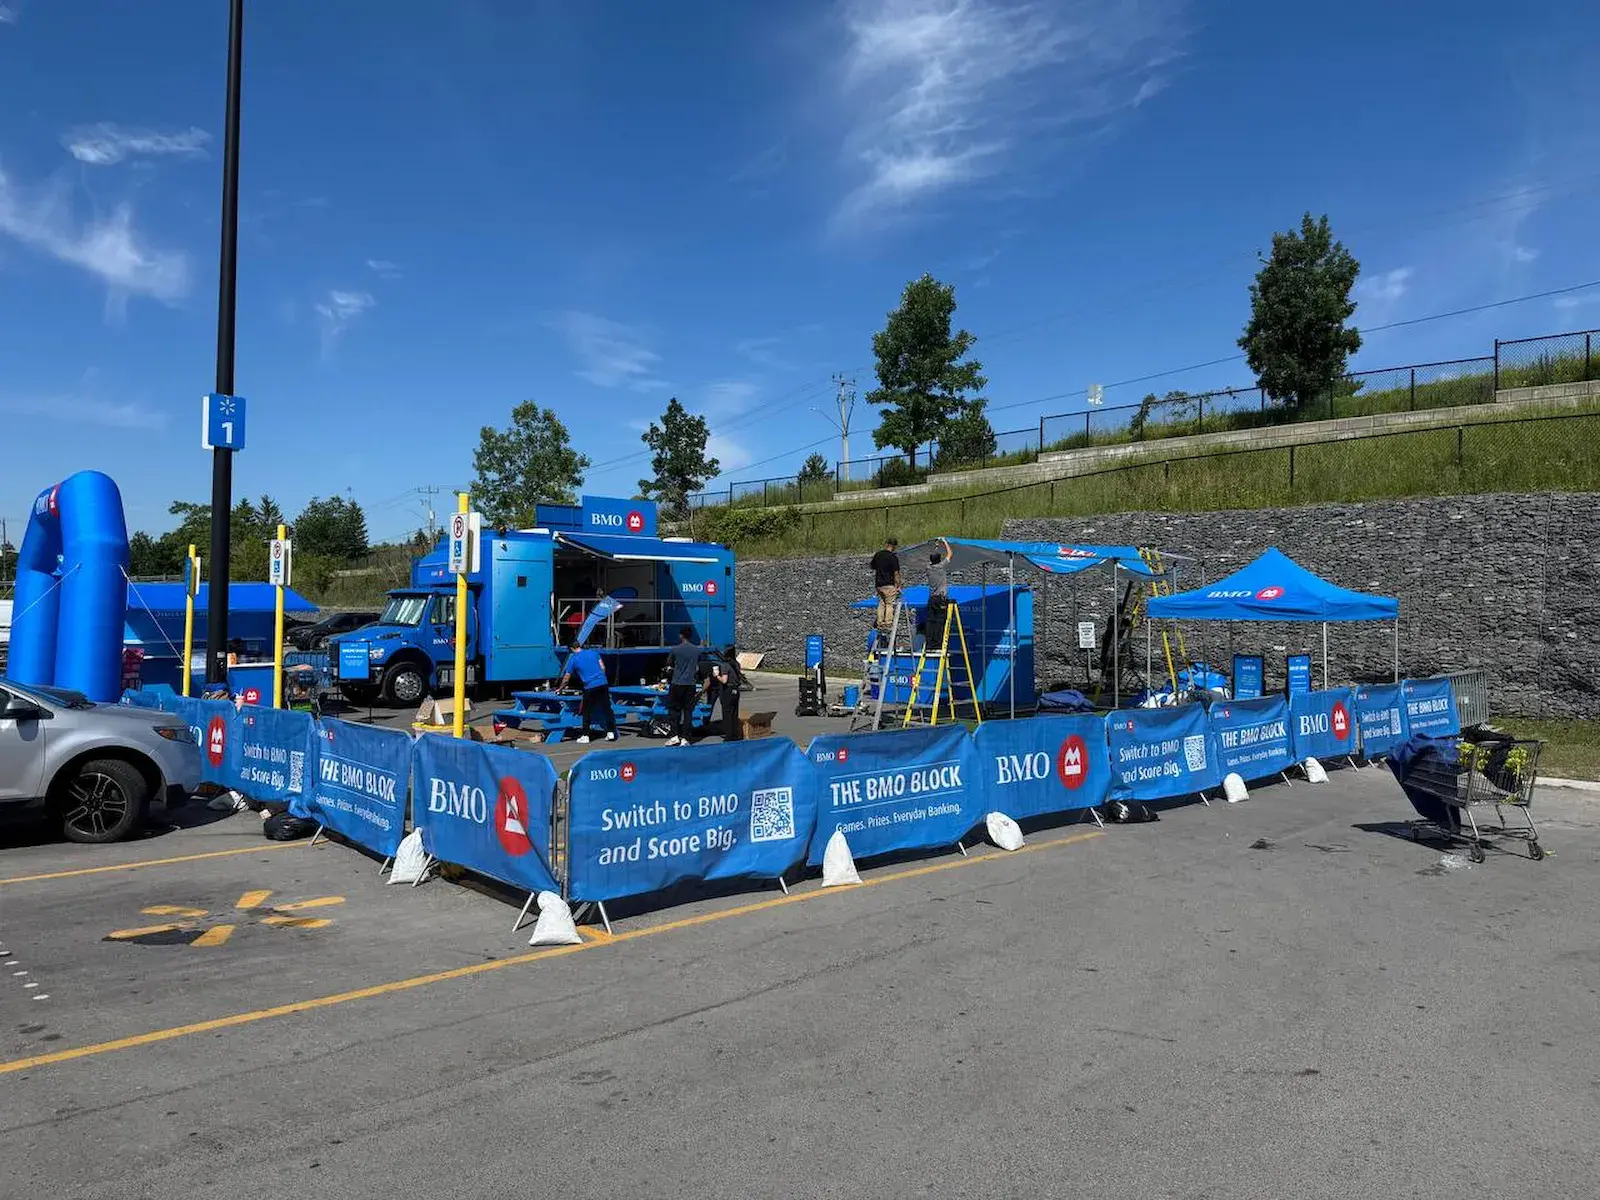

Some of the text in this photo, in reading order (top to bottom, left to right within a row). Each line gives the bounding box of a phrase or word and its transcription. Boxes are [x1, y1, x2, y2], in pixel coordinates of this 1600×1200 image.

[221, 422, 234, 444] 1
[591, 513, 623, 527] BMO
[682, 583, 703, 593] BMO
[1207, 590, 1252, 600] BMO
[1221, 721, 1287, 748] THE BMO BLOCK
[1300, 713, 1328, 736] BMO
[816, 752, 834, 762] BMO
[1120, 740, 1179, 762] Switch to BMO
[251, 767, 271, 784] Score
[320, 758, 340, 781] THE
[341, 764, 363, 790] BMO
[590, 768, 618, 781] BMO
[996, 752, 1050, 784] BMO
[1138, 765, 1162, 780] Score
[1164, 760, 1182, 777] Big.
[830, 765, 962, 806] THE BMO BLOCK
[428, 777, 487, 825] BMO
[601, 793, 739, 832] Switch to BMO
[835, 802, 962, 834] Games. Prizes. Everyday Banking.
[598, 825, 738, 866] and Score Big.
